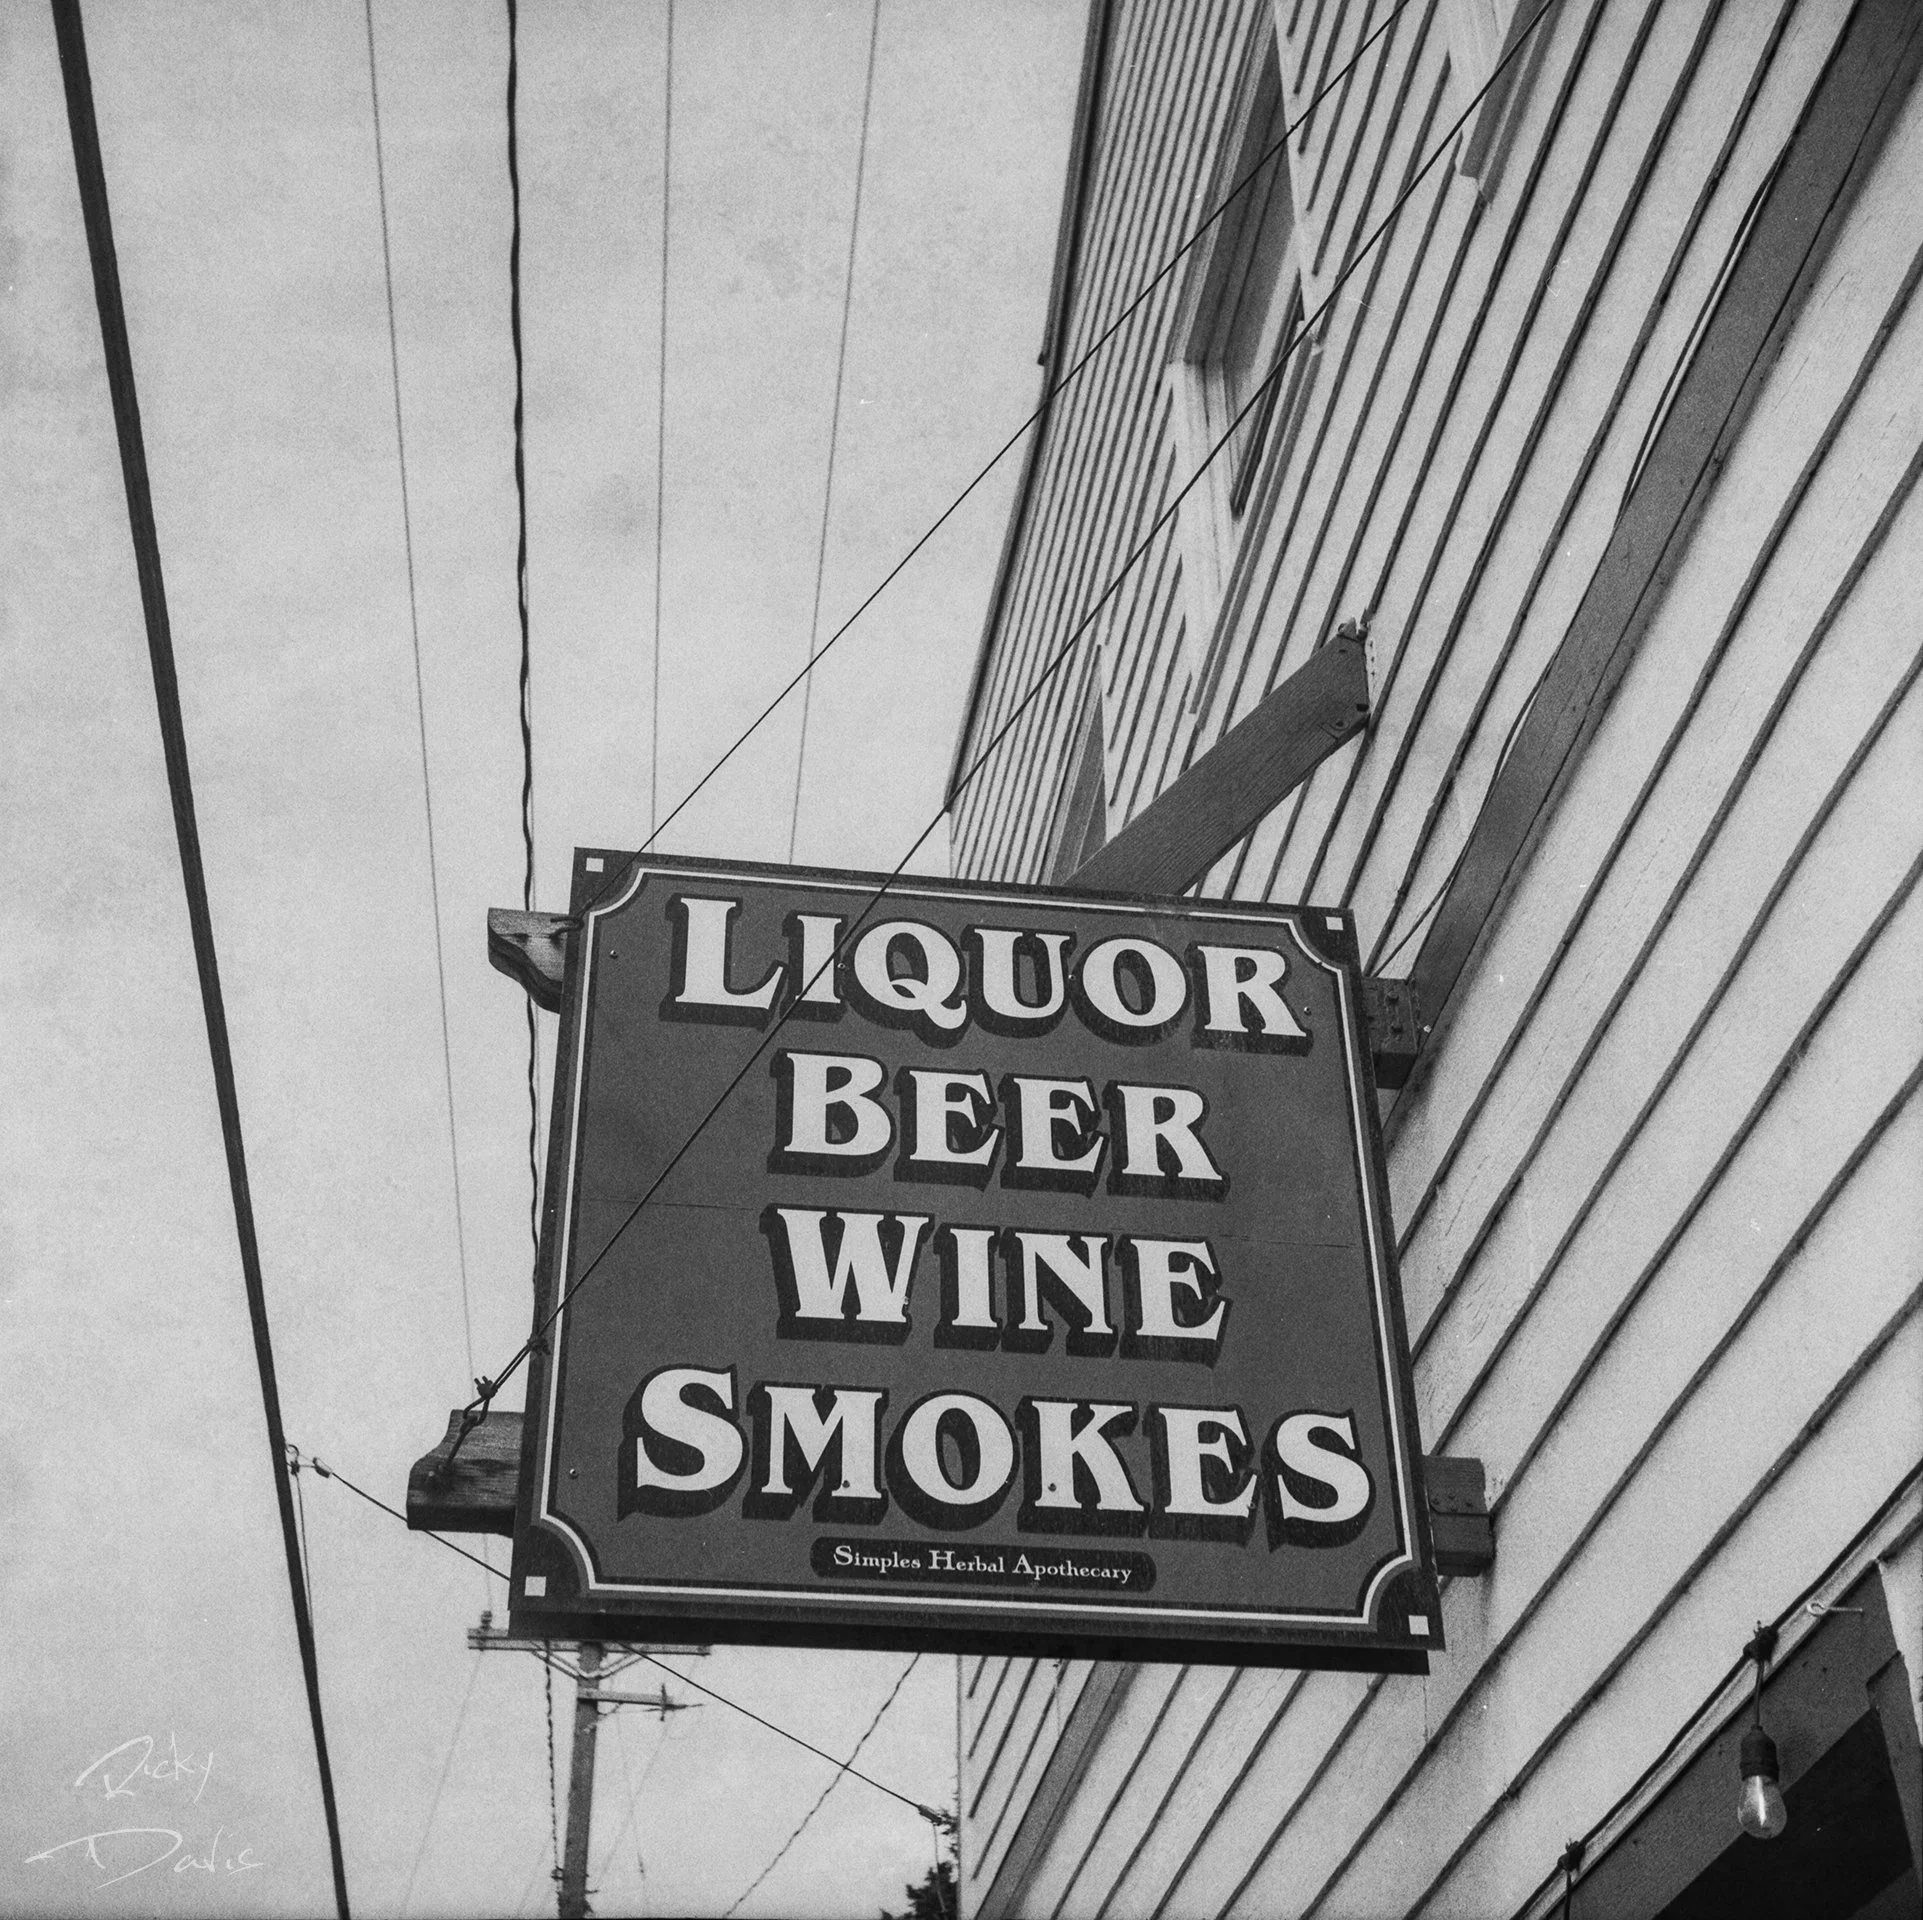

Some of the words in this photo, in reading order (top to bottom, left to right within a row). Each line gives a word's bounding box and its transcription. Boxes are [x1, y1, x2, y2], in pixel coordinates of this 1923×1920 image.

[674, 896, 1309, 1039] LIQUOR
[783, 1051, 1223, 1182] BEER
[776, 1206, 1227, 1342] WINE
[634, 1366, 1372, 1523] SMOKES
[832, 1544, 921, 1574] Simples
[927, 1549, 1005, 1574] Herbal
[1011, 1553, 1133, 1584] Apothecary
